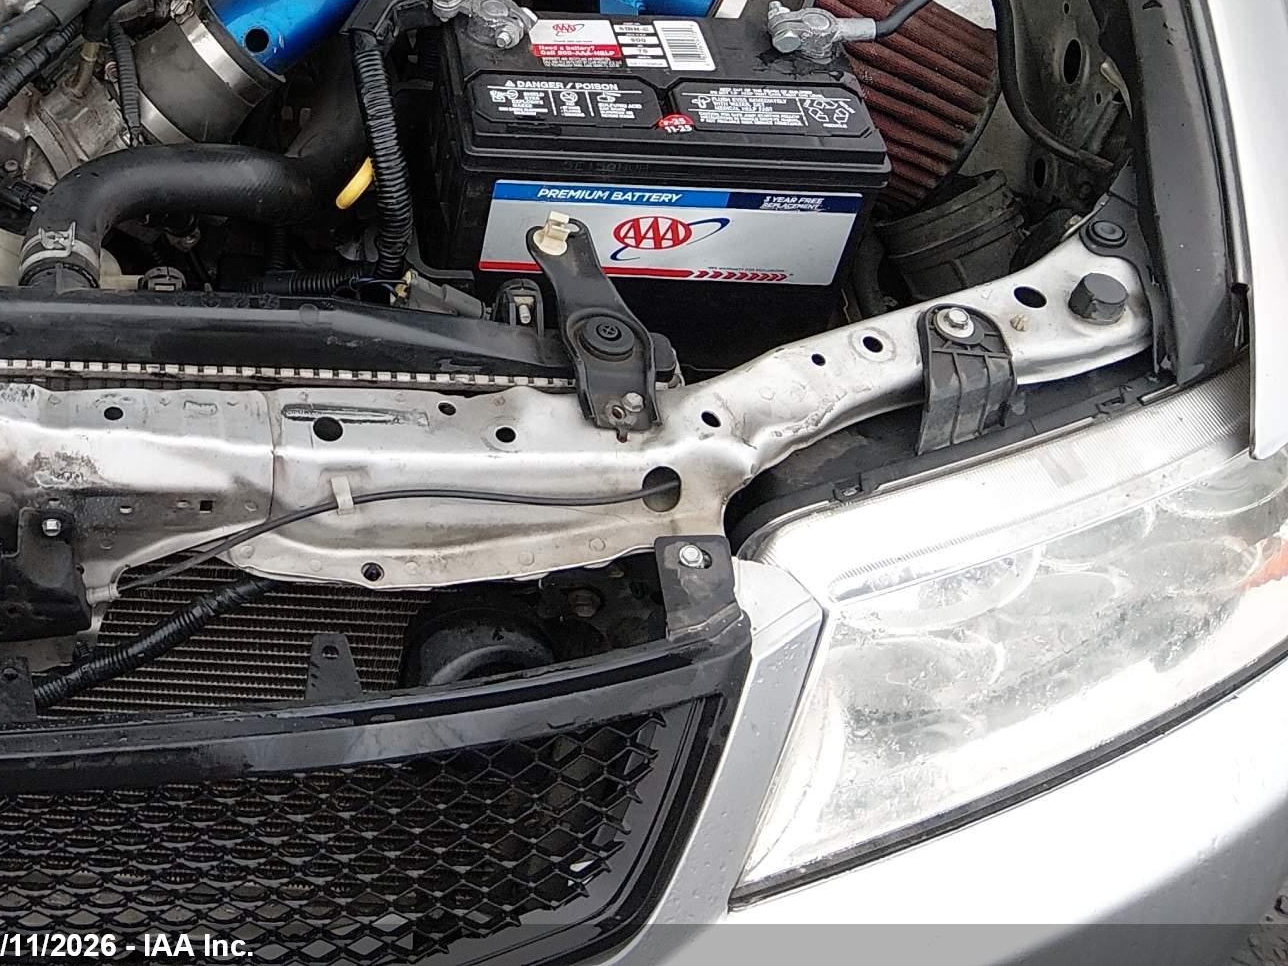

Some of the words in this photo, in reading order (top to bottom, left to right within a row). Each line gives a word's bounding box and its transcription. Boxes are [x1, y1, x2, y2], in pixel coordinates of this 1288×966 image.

[516, 80, 564, 89] DANGER
[575, 82, 619, 91] POISON
[537, 188, 609, 200] PREMIUM
[611, 191, 683, 203] BATTERY
[798, 197, 825, 206] FREE
[616, 217, 689, 249] AAA
